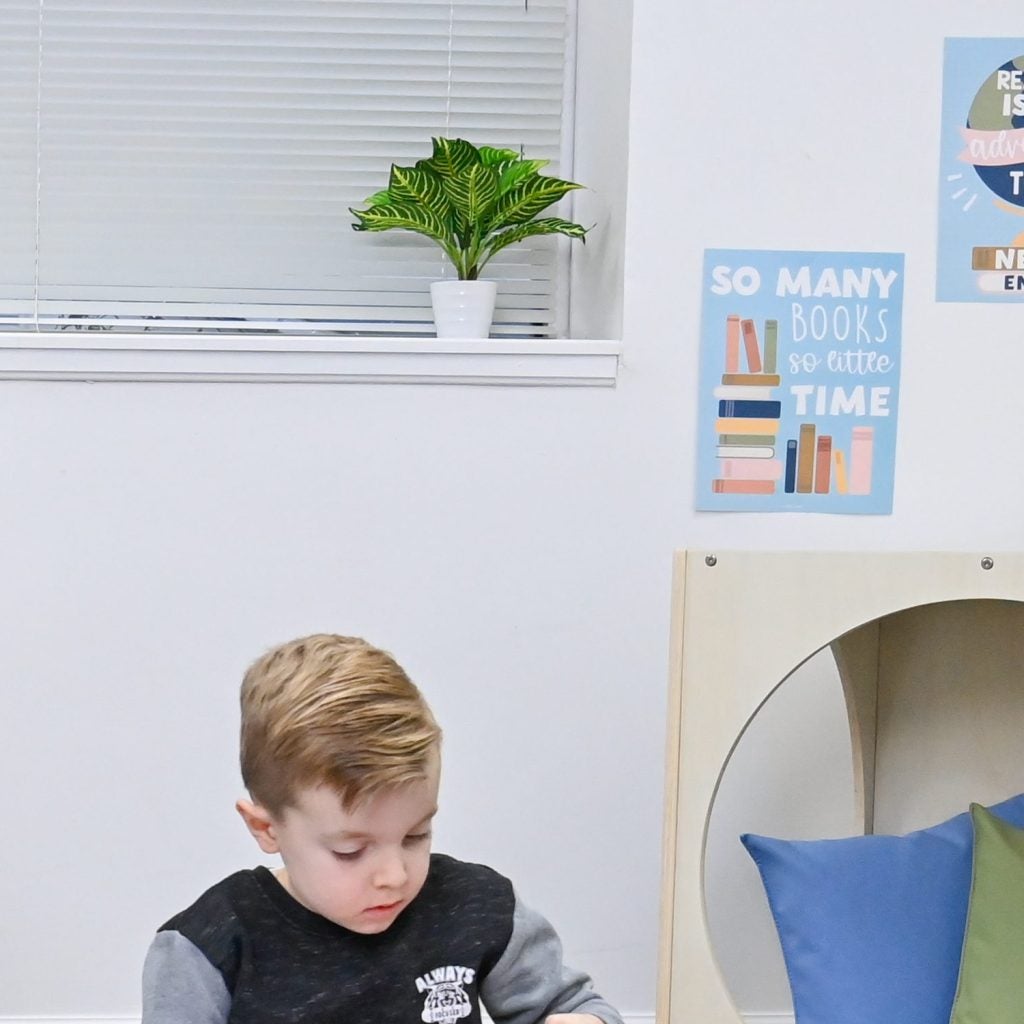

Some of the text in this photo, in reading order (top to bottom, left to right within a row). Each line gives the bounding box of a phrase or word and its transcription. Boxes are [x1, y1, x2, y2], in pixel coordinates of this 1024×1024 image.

[710, 265, 898, 299] SO MANY
[791, 302, 888, 344] BOOKS
[789, 349, 895, 375] so little
[790, 385, 891, 416] TIME
[415, 965, 476, 993] ALWAYS
